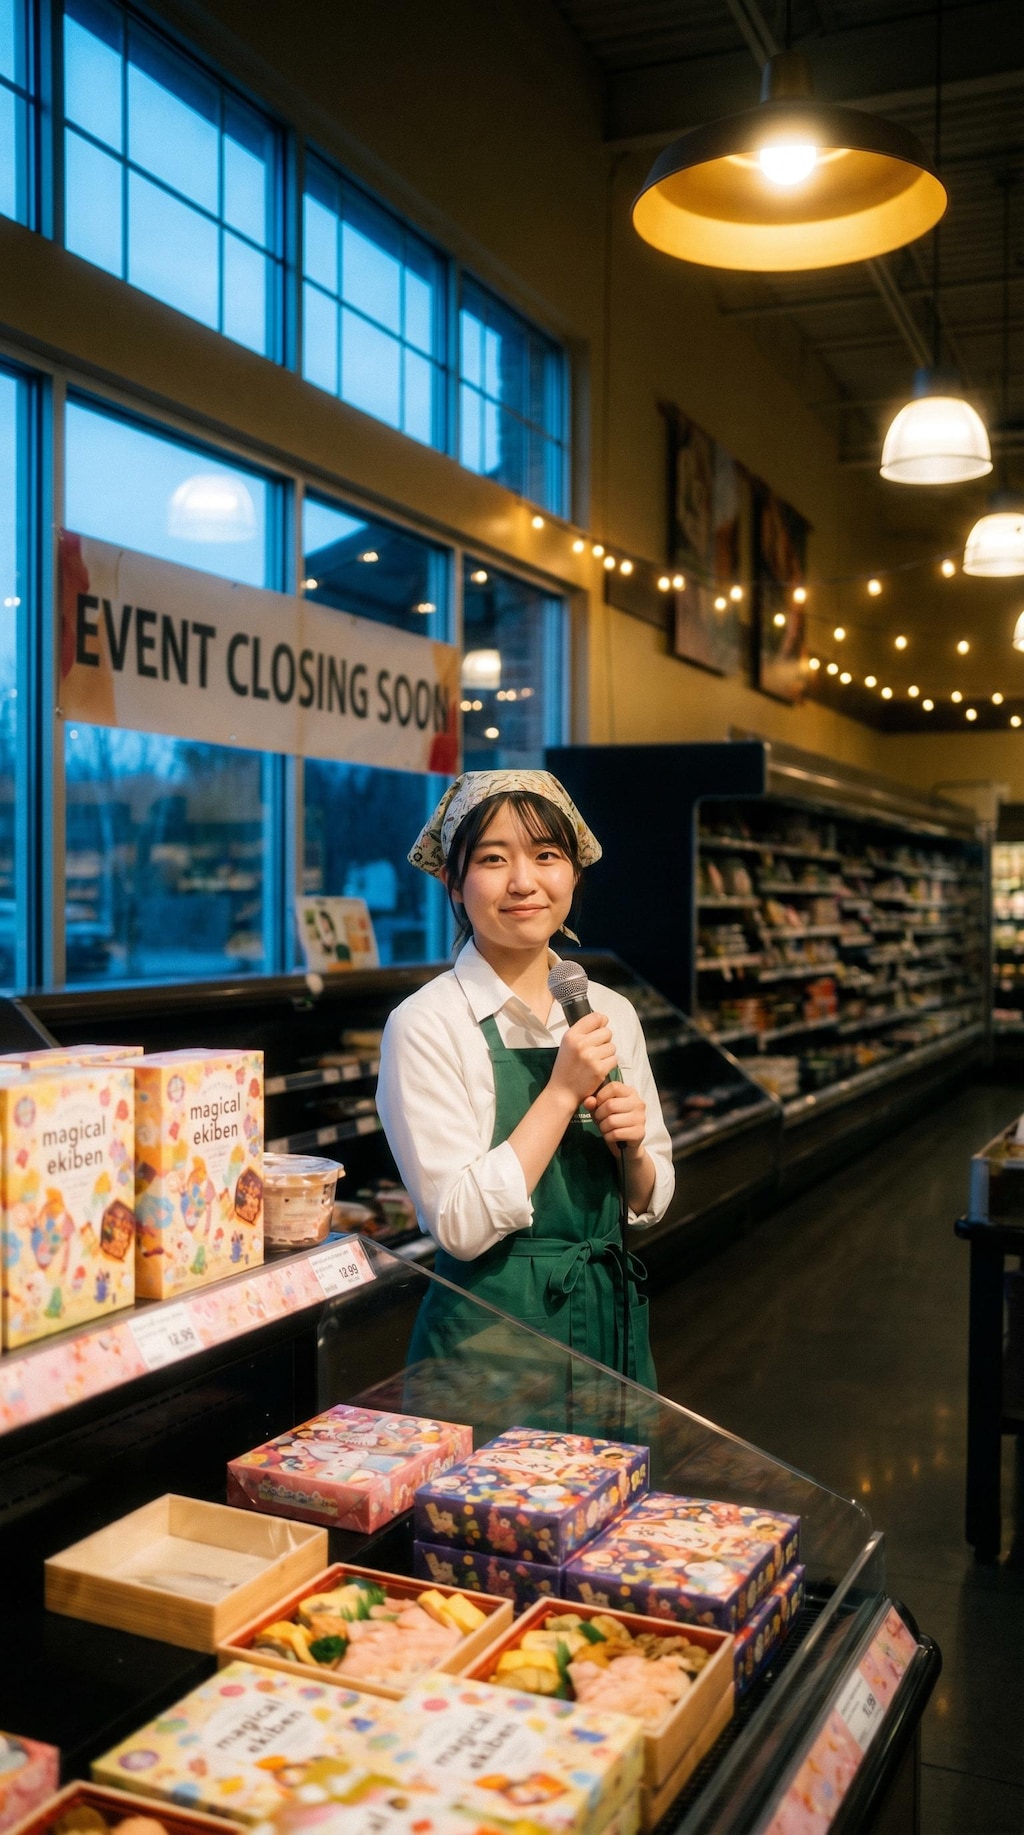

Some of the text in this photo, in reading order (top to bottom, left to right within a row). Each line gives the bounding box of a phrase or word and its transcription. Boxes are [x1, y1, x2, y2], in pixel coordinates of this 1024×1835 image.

[75, 593, 449, 734] EVENT CLOSING SOON
[190, 1091, 241, 1122] magical
[42, 1114, 106, 1148] magical
[193, 1119, 239, 1146] ekiben
[46, 1148, 104, 1175] ekiben
[215, 1698, 284, 1751] magical
[247, 1709, 306, 1754] ekiben
[433, 1709, 497, 1768] magical
[468, 1721, 521, 1771] ekiben
